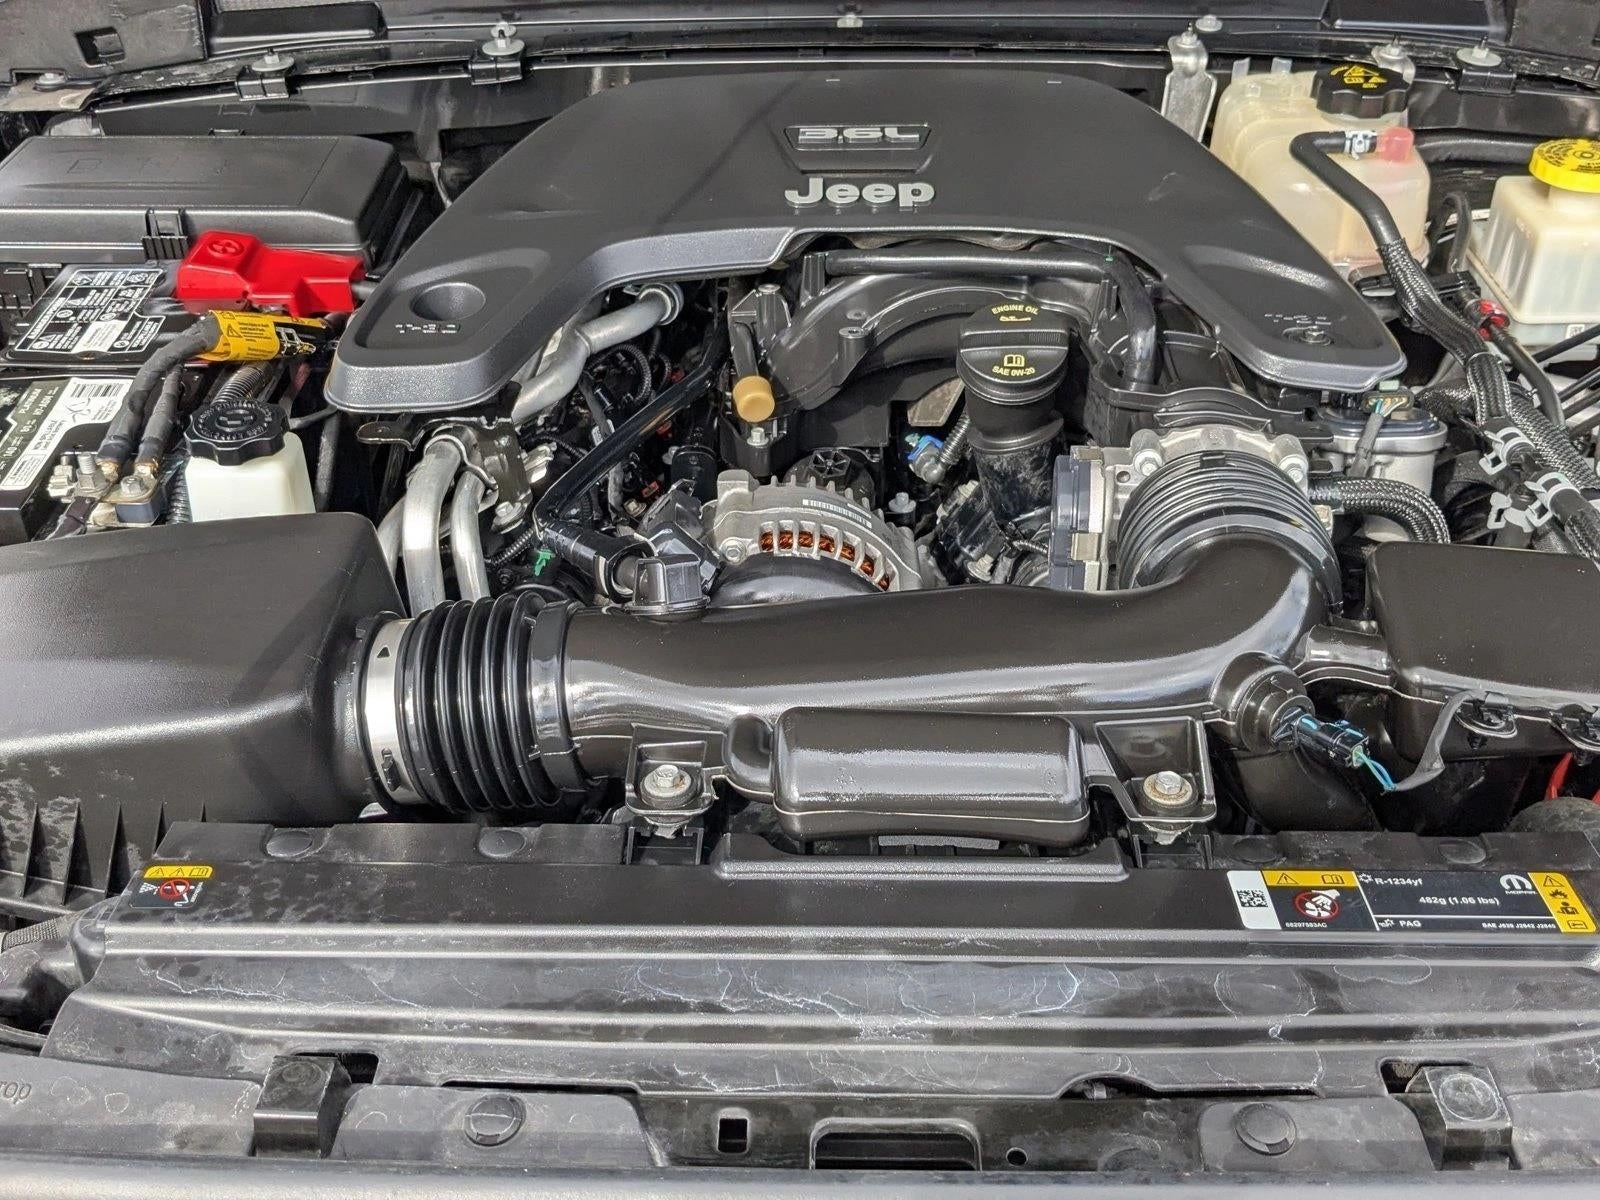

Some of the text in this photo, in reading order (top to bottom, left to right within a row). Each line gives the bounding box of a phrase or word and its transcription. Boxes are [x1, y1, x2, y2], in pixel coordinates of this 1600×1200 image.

[798, 127, 920, 144] 3.6L
[785, 178, 935, 208] Jeep
[991, 304, 1039, 315] ENGINE OIL
[992, 366, 1035, 376] SAE 0W-20
[18, 388, 42, 414] PLATINUM
[1375, 877, 1422, 887] R-1234yf
[1419, 897, 1446, 905] 482g
[1478, 897, 1500, 905] lbs)
[1399, 920, 1422, 928] PAG
